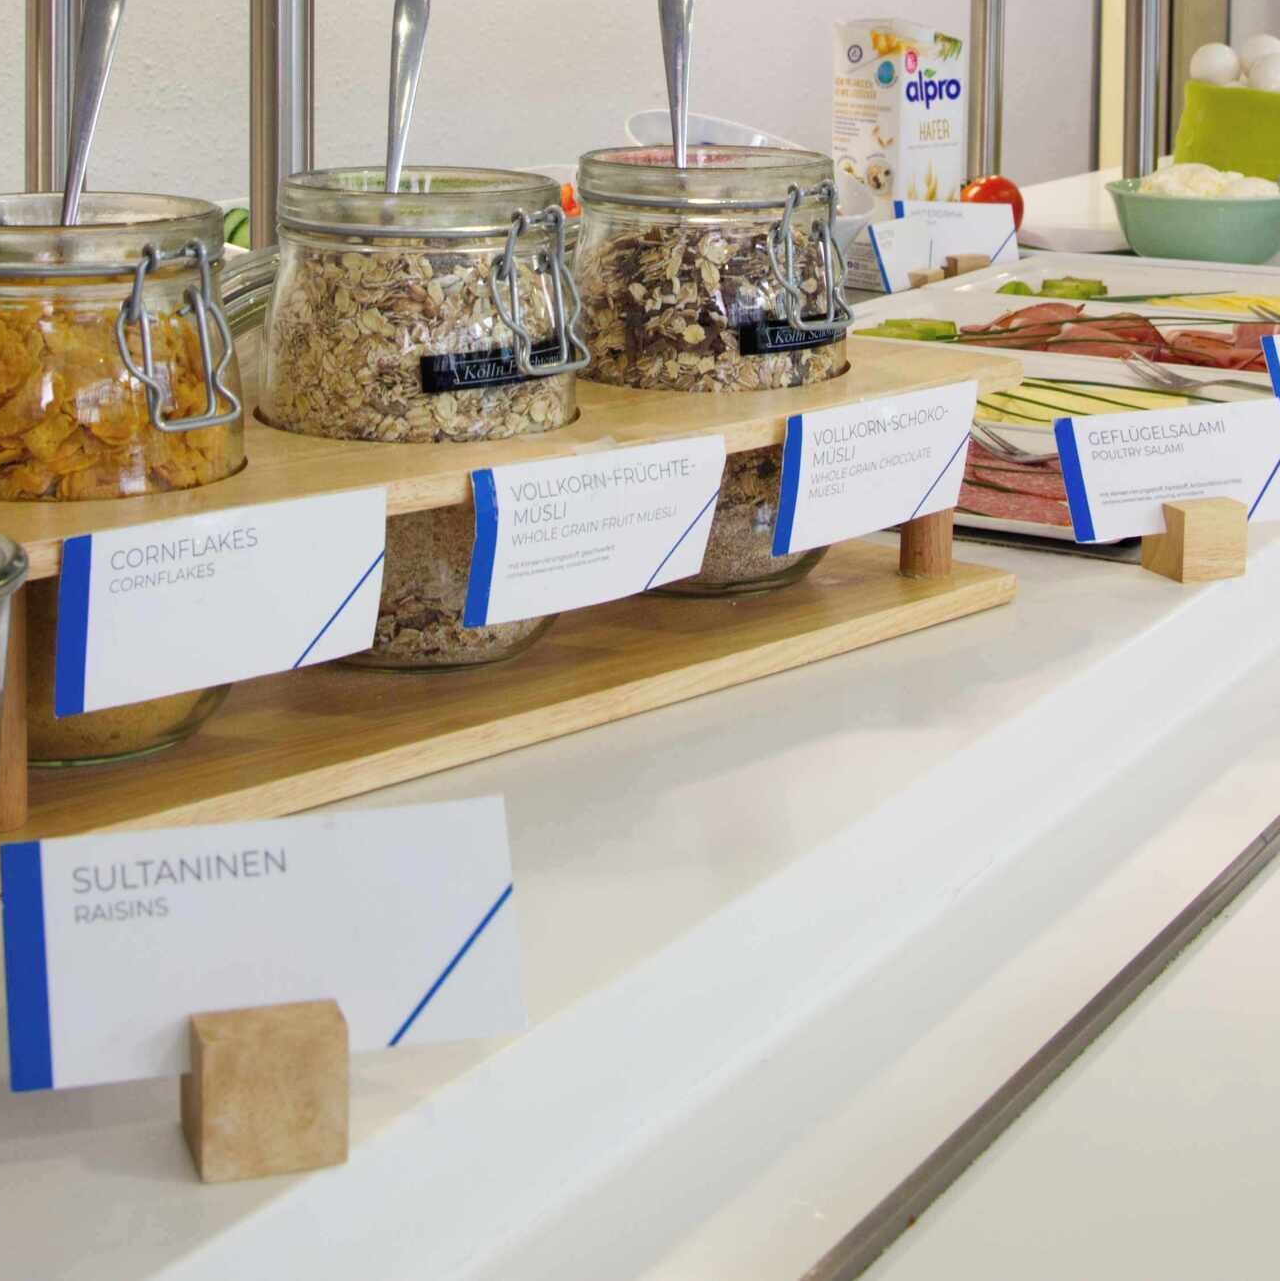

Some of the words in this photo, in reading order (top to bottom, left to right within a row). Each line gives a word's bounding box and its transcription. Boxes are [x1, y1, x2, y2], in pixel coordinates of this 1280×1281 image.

[906, 70, 961, 109] alpro
[919, 118, 950, 142] HAFER
[464, 360, 507, 381] Kölln
[813, 405, 949, 447] VOLLKORN-SCHOKO-
[1087, 419, 1226, 446] GEFLÜGELSALAMI
[812, 445, 856, 468] MÜSLI
[1091, 446, 1142, 461] POULTRY
[1144, 443, 1184, 457] SALAMI
[510, 458, 697, 503] VOLLKORN-FRÜCHTE-
[810, 467, 847, 485] WHOLE
[511, 527, 558, 547] WHOLE
[560, 521, 599, 540] GRAIN
[601, 515, 635, 530] FRUIT
[637, 506, 678, 524] MUESLI
[513, 501, 568, 527] MÜSLI
[110, 526, 259, 571] CORNFLAKES
[108, 562, 216, 595] CORNFLAKES
[71, 848, 288, 895] SULTANINEN
[73, 896, 170, 925] RAISINS
